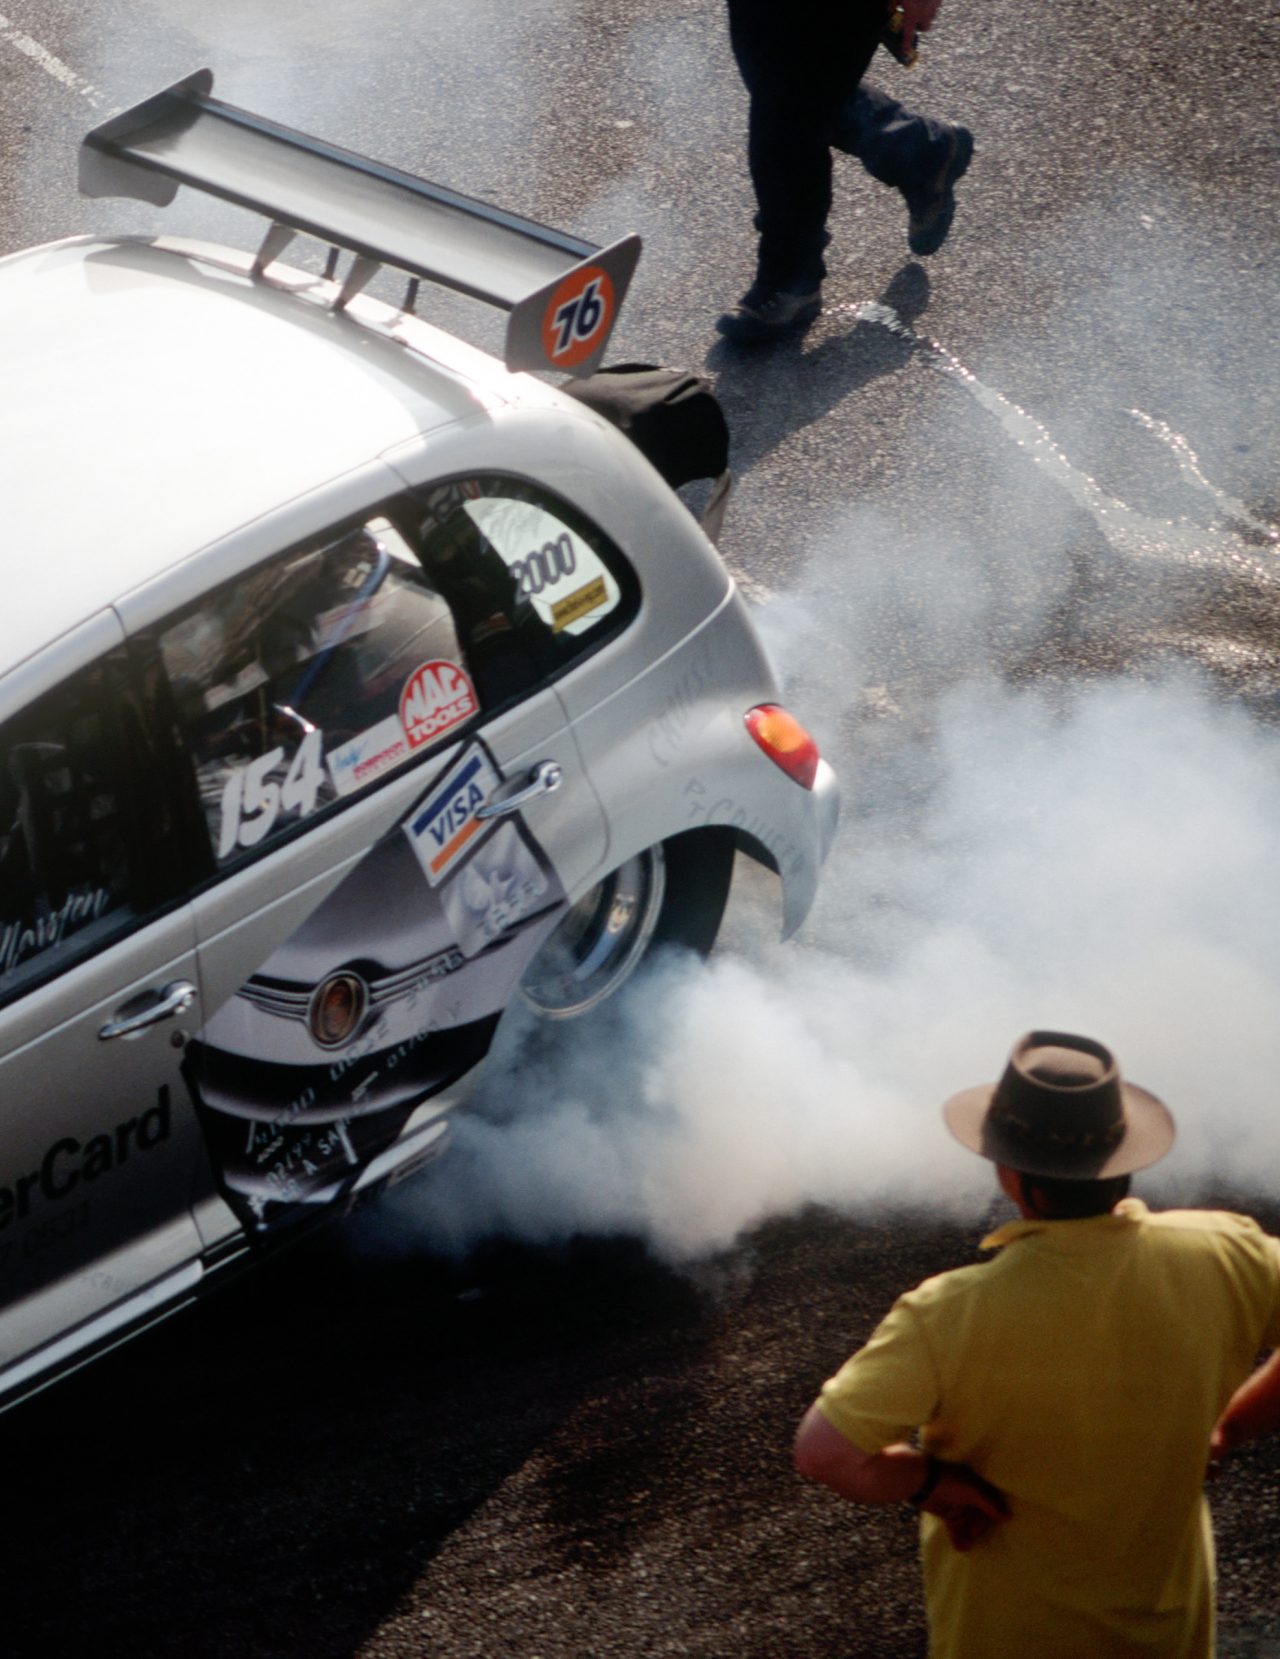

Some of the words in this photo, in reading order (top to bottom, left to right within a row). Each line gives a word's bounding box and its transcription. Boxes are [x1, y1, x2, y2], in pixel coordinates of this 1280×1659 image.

[550, 276, 605, 358] 76
[511, 532, 577, 605] 2000
[405, 667, 470, 729] MAC
[408, 697, 472, 742] TOOLS
[217, 728, 326, 860] 154
[429, 782, 485, 846] VISA
